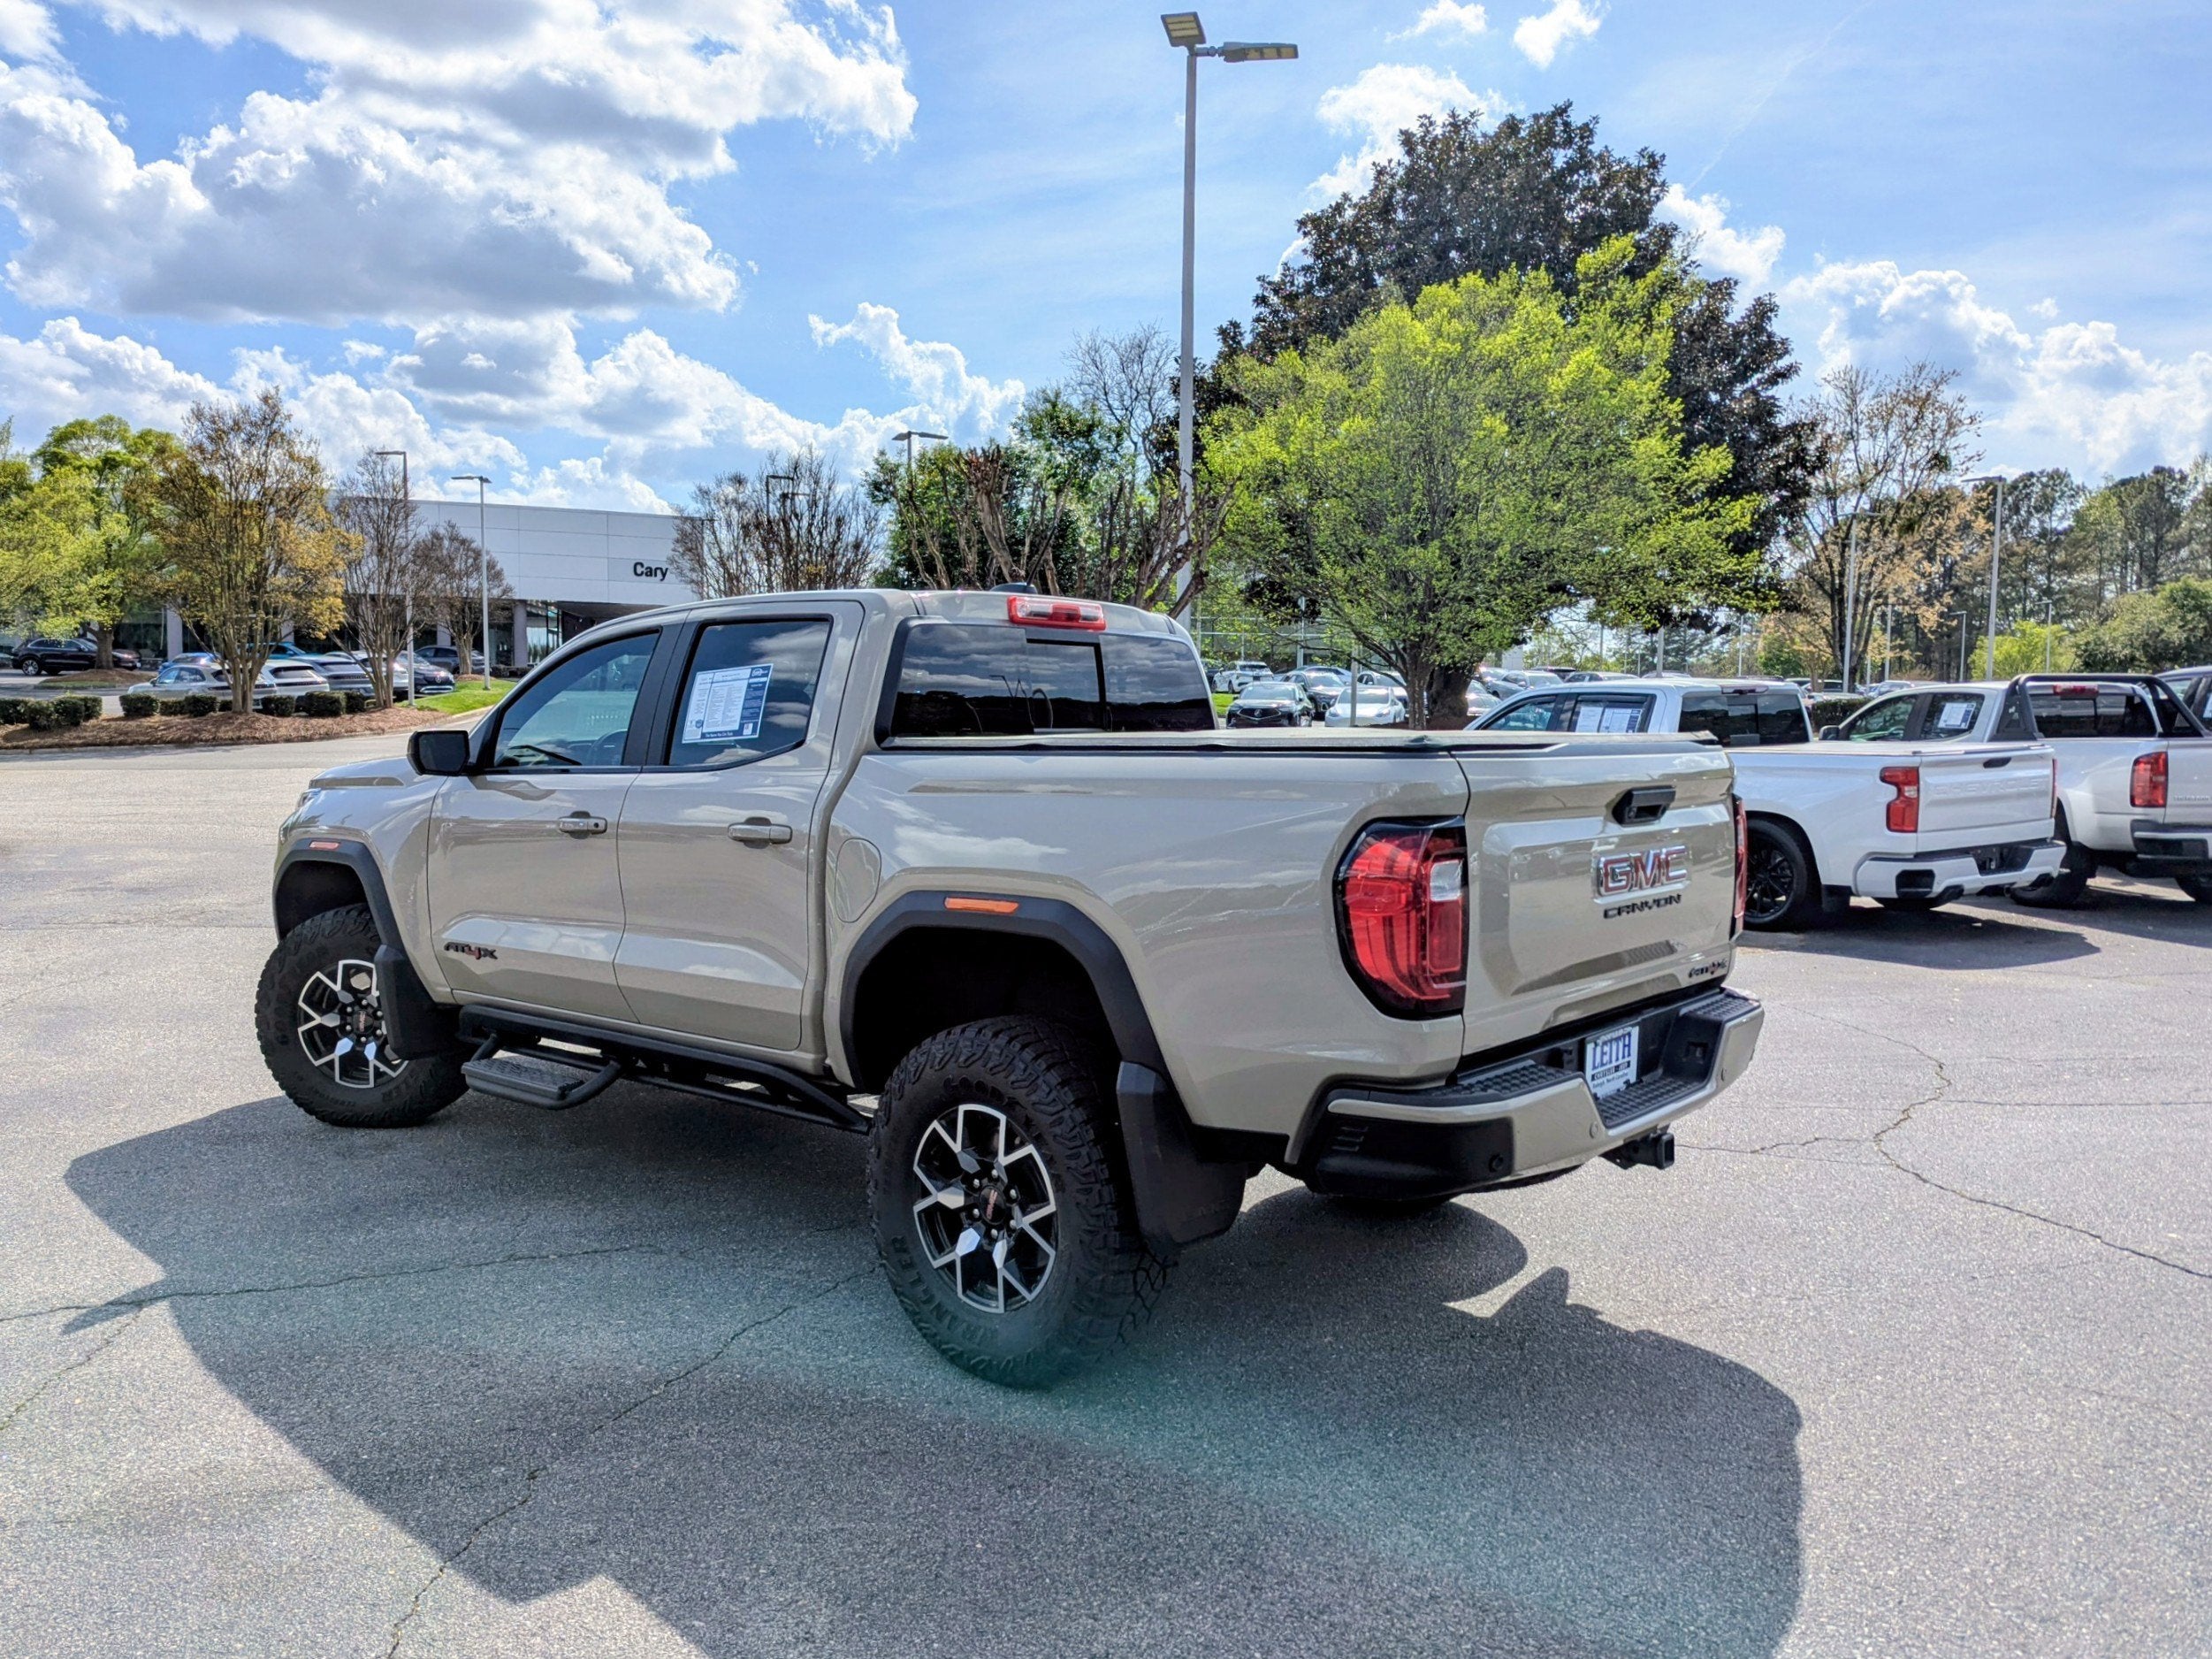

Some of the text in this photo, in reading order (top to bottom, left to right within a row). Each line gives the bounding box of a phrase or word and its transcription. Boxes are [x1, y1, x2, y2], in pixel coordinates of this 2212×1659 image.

[633, 562, 669, 582] Cary
[1598, 845, 1688, 896] GMC
[1603, 893, 1682, 919] CANYON
[444, 942, 498, 960] AT4X
[1591, 1032, 1632, 1071] LEITH
